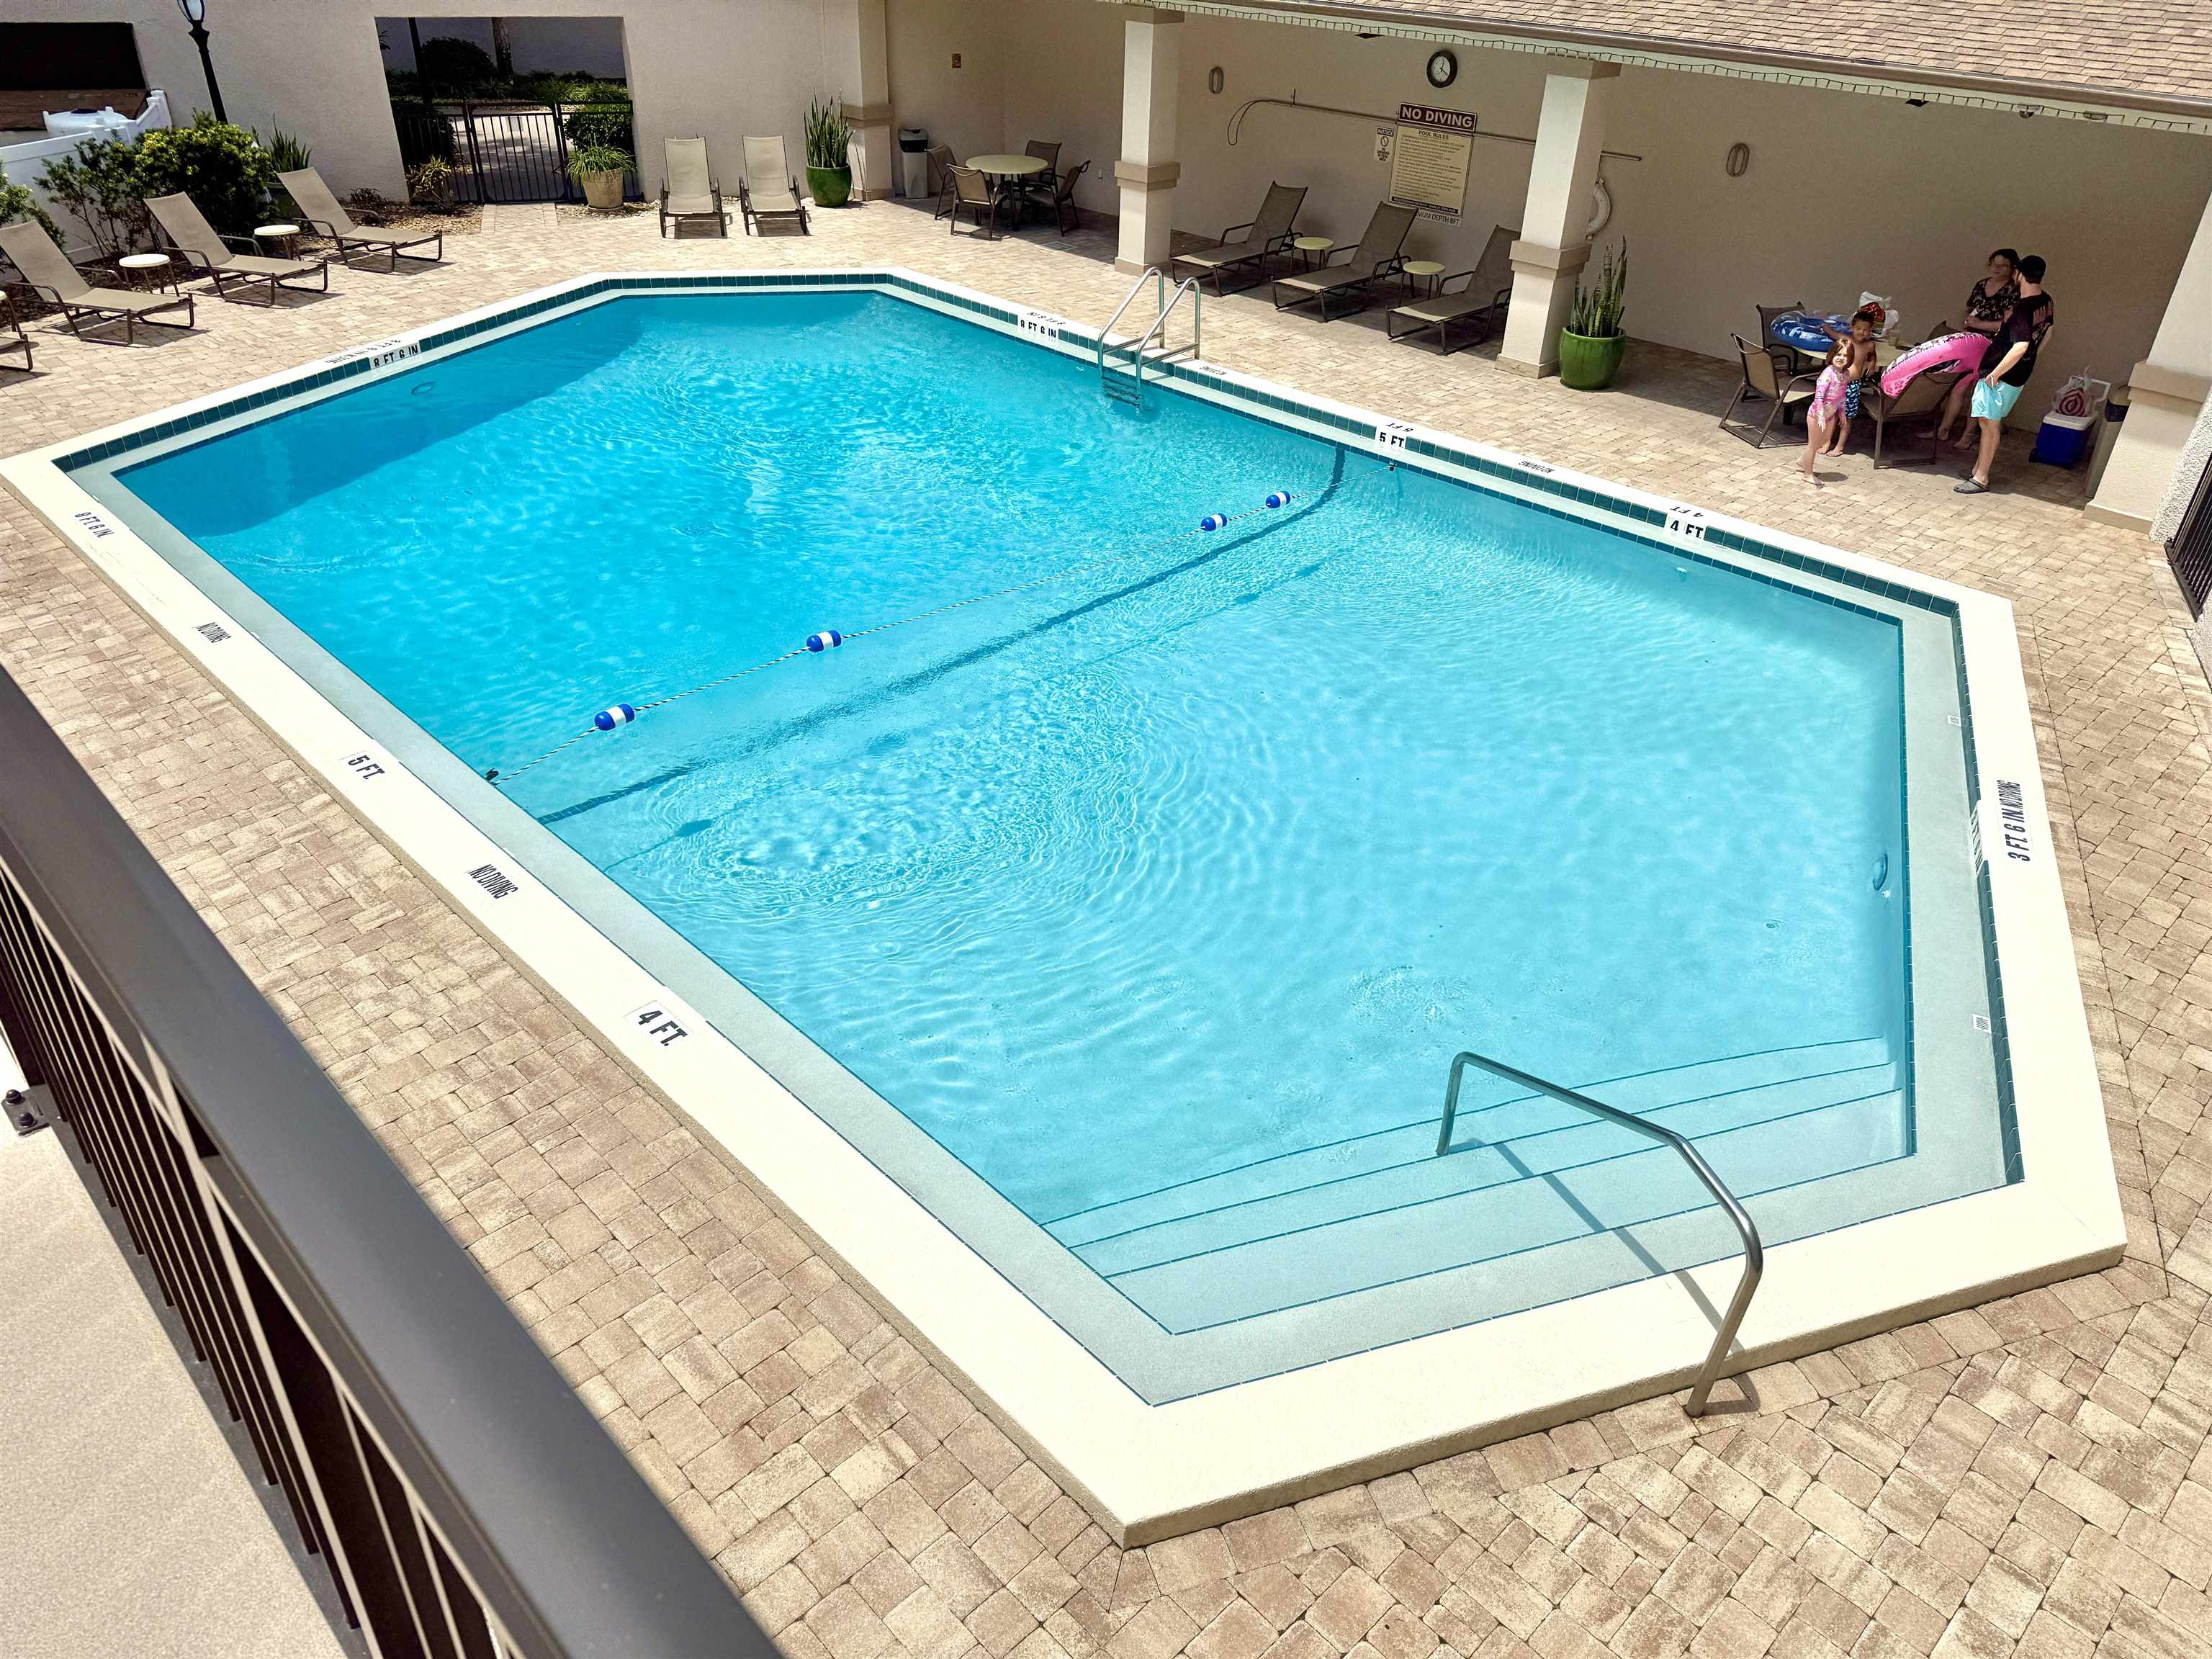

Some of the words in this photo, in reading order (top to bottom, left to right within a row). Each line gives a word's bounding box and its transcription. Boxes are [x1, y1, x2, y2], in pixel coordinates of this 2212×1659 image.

[1402, 107, 1421, 120] NO
[1425, 110, 1473, 128] DIVING
[1432, 213, 1449, 222] DEPTH
[1020, 319, 1025, 328] 8
[1028, 321, 1038, 332] FT
[1040, 325, 1046, 335] 6
[1048, 328, 1056, 338] IN
[374, 357, 380, 367] 8
[383, 352, 394, 364] FT
[399, 349, 405, 359] 6
[408, 344, 418, 356] IN
[1379, 431, 1387, 443] 5
[1670, 519, 1679, 531] 4
[348, 755, 371, 766] 5
[2003, 823, 2026, 833] 6
[2008, 852, 2031, 862] 3
[477, 871, 518, 899] DIVING
[638, 1010, 663, 1025] 4
